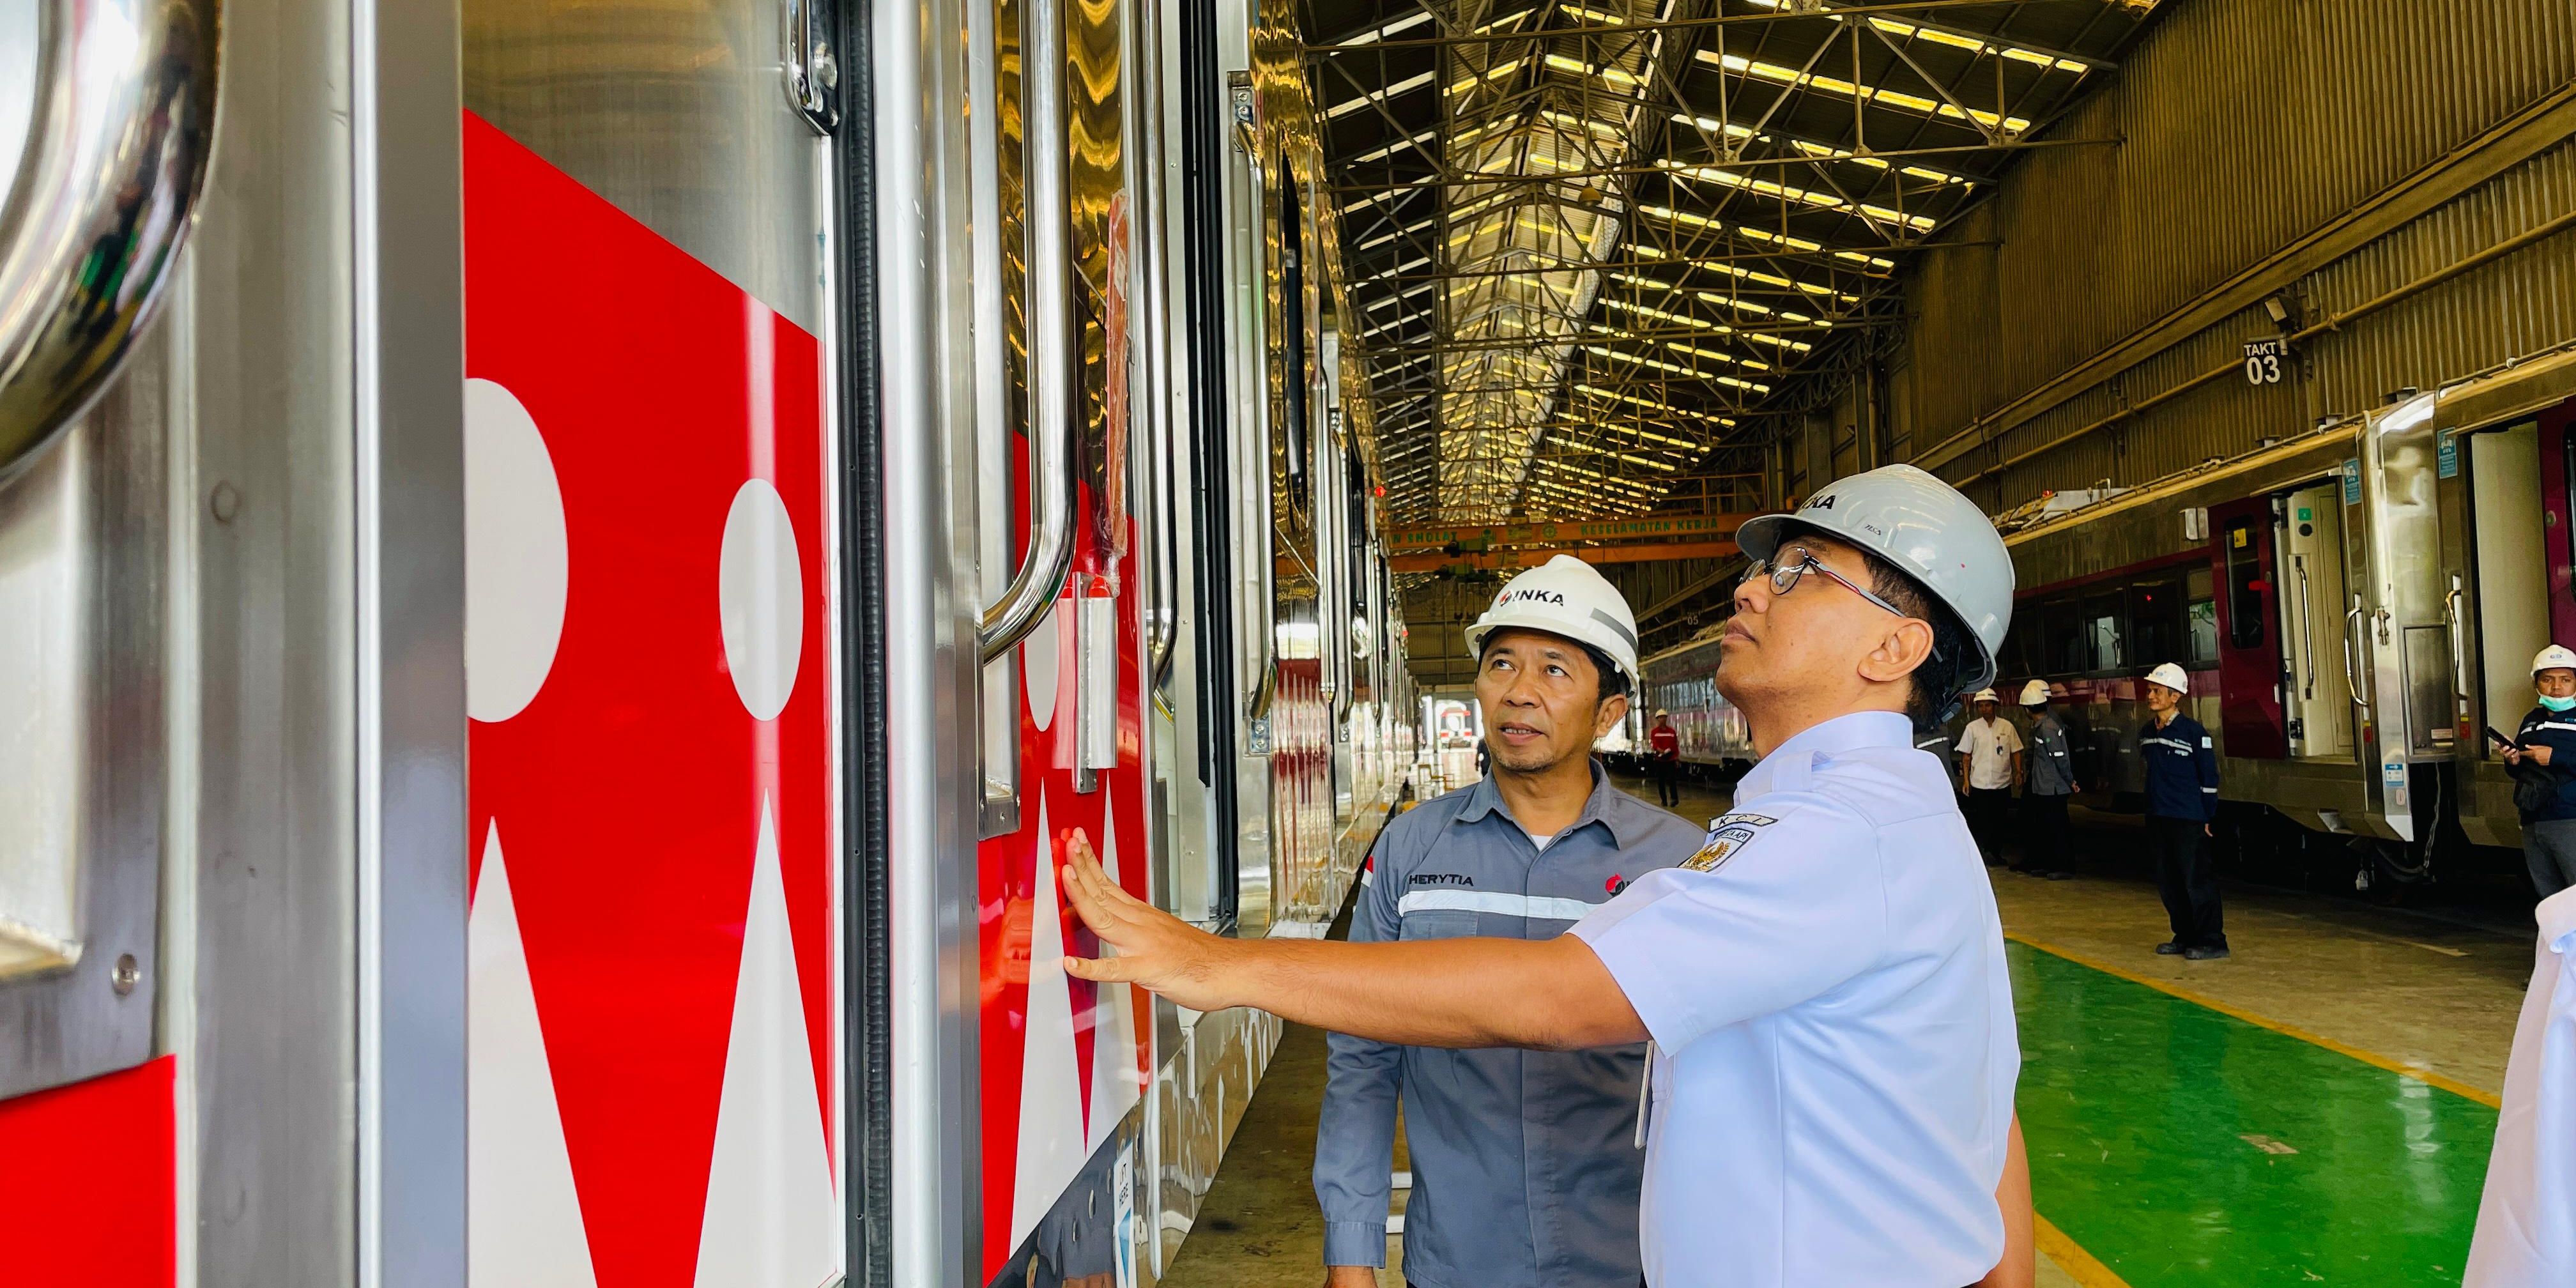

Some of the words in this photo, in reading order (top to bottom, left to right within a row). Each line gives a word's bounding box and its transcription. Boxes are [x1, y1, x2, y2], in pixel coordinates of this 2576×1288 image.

[2244, 342, 2276, 356] TAKT
[2246, 355, 2281, 385] 03
[1581, 521, 1671, 535] KESELAMATAN
[1677, 516, 1717, 530] KERJA
[1512, 589, 1563, 607] INKA
[1409, 873, 1474, 887] HERYTIA
